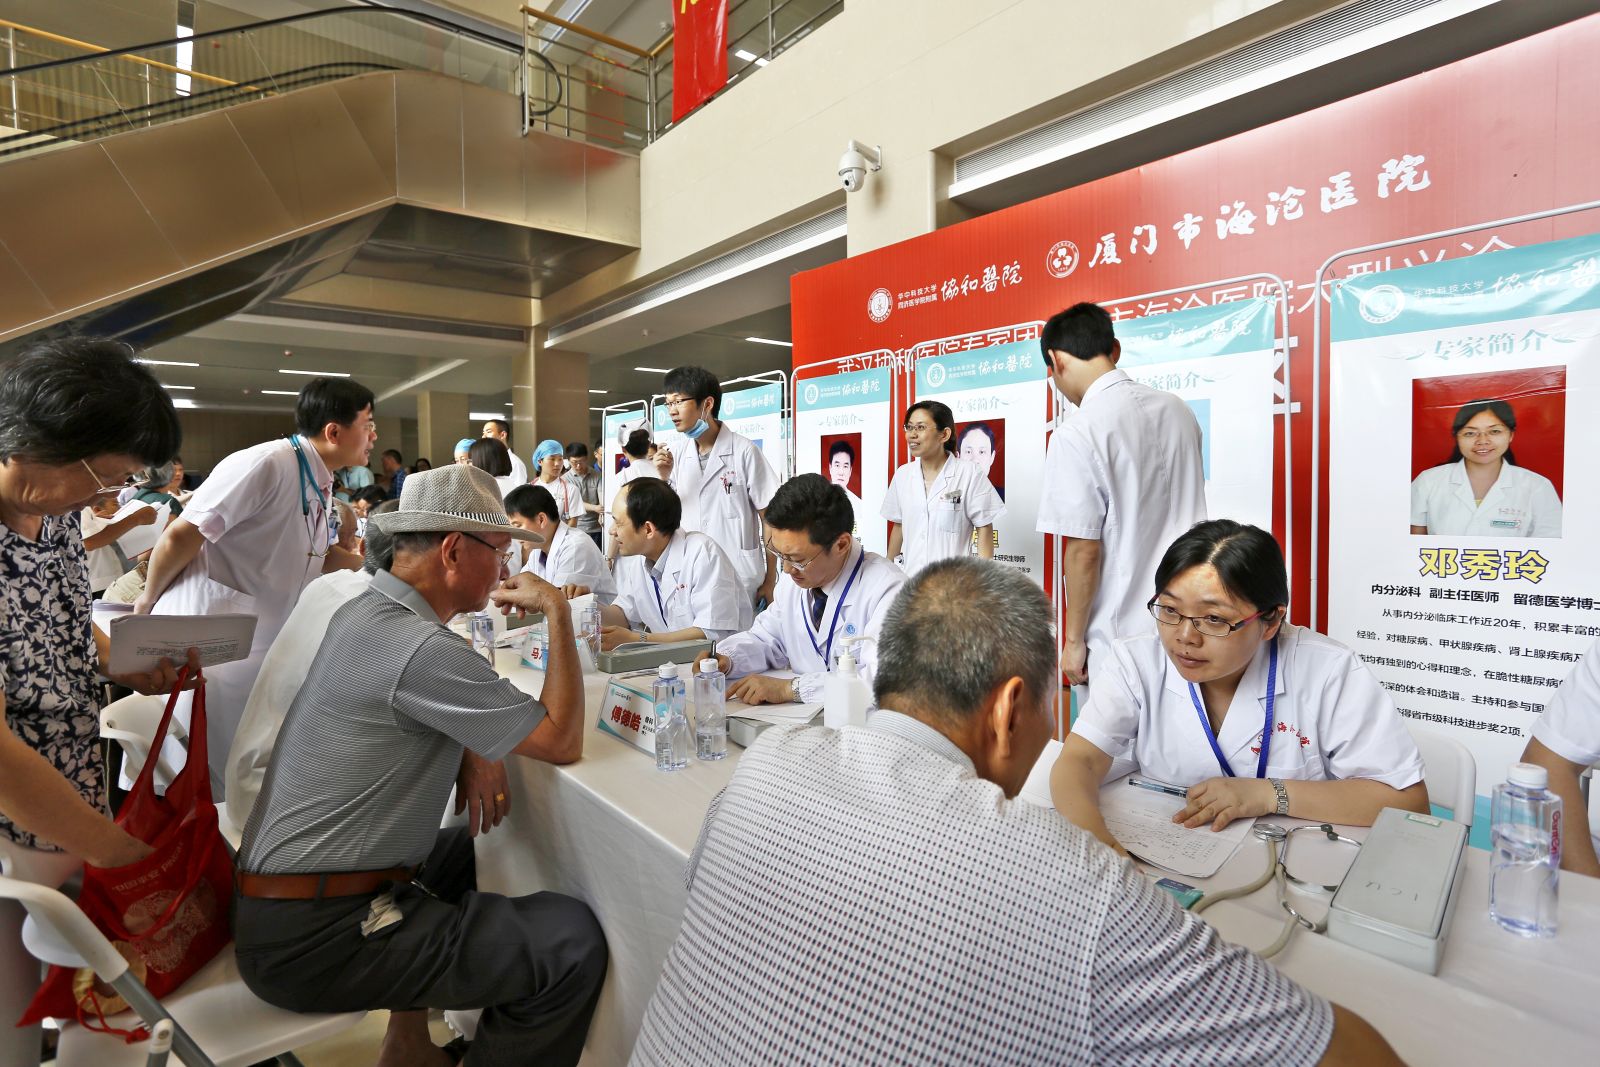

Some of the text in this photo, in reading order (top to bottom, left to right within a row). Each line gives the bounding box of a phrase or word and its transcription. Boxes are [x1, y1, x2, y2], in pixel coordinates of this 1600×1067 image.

[1088, 154, 1432, 268] 厦门市海沧医院
[1433, 329, 1549, 361] 专家简介
[1419, 548, 1549, 584] 邓秀玲
[1371, 583, 1421, 598] 内分泌科
[1429, 587, 1500, 604] 副主任医师
[1359, 654, 1563, 688] 均有独到的心得和理念，在脆性糖尿病
[1379, 681, 1545, 713] 深的体会和造诣。主持和参与国
[1397, 707, 1525, 738] 得省市级科技进步奖2项，
